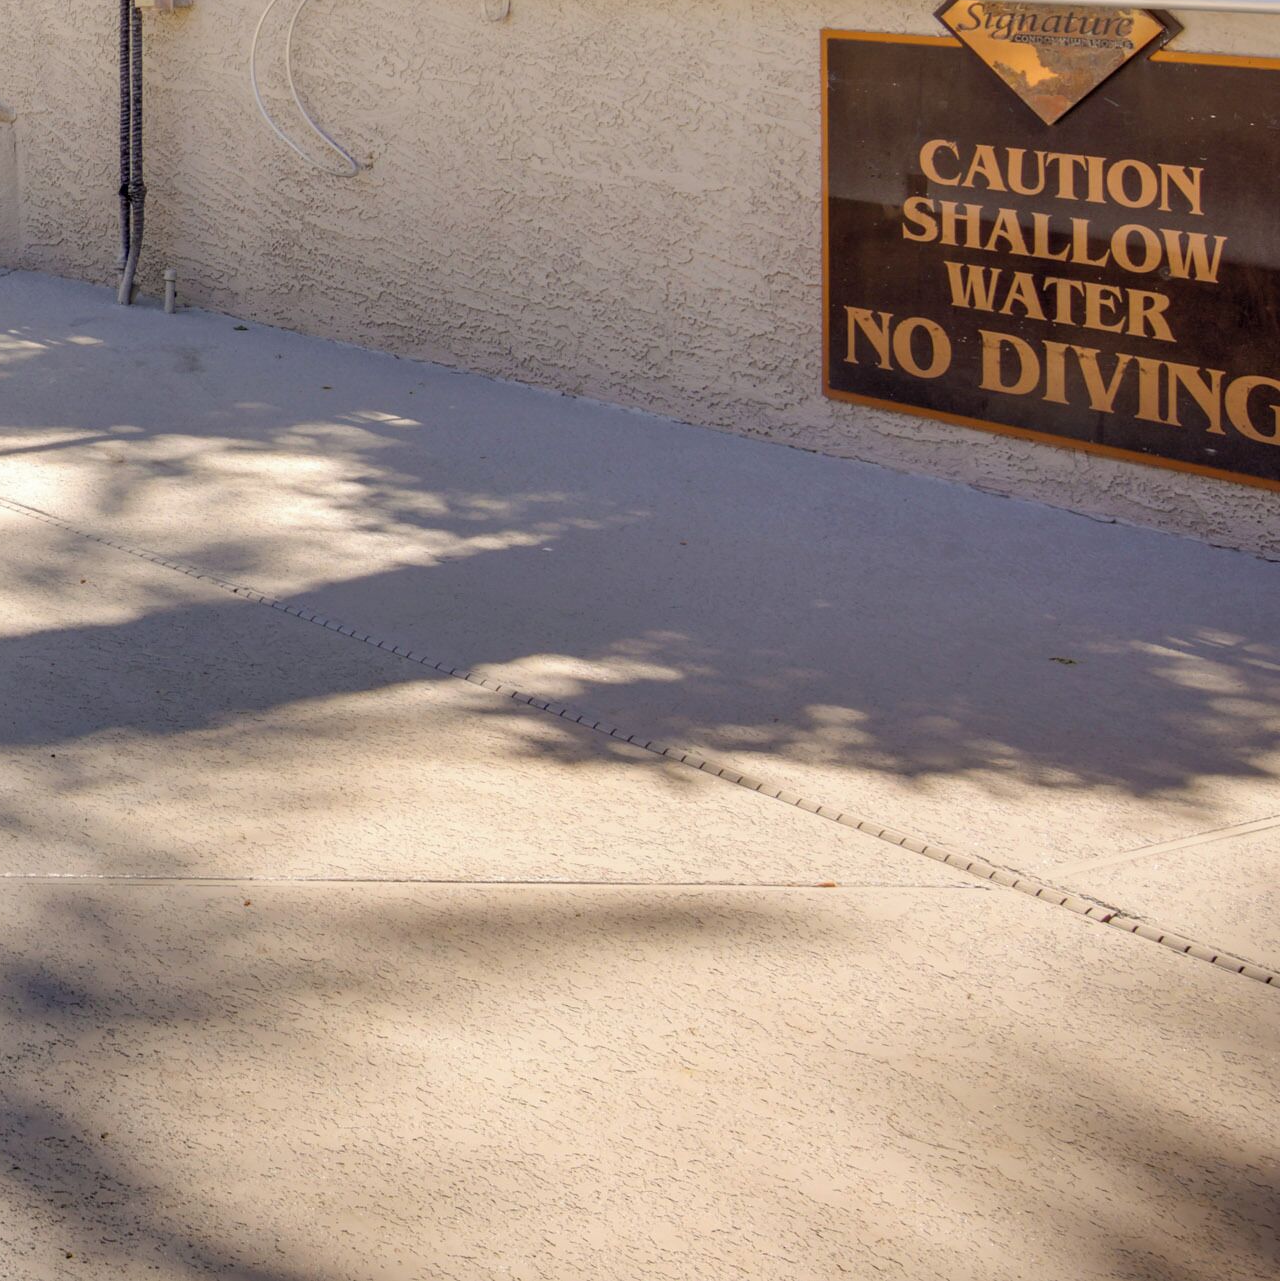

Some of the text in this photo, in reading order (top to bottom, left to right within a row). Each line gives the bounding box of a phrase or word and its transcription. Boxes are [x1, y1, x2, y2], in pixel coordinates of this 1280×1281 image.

[956, 2, 1135, 40] Signature
[919, 139, 1205, 216] CAUTION
[902, 196, 1228, 283] SHALLOW
[944, 261, 1178, 343] WATER
[843, 305, 1280, 446] NO DIVING
